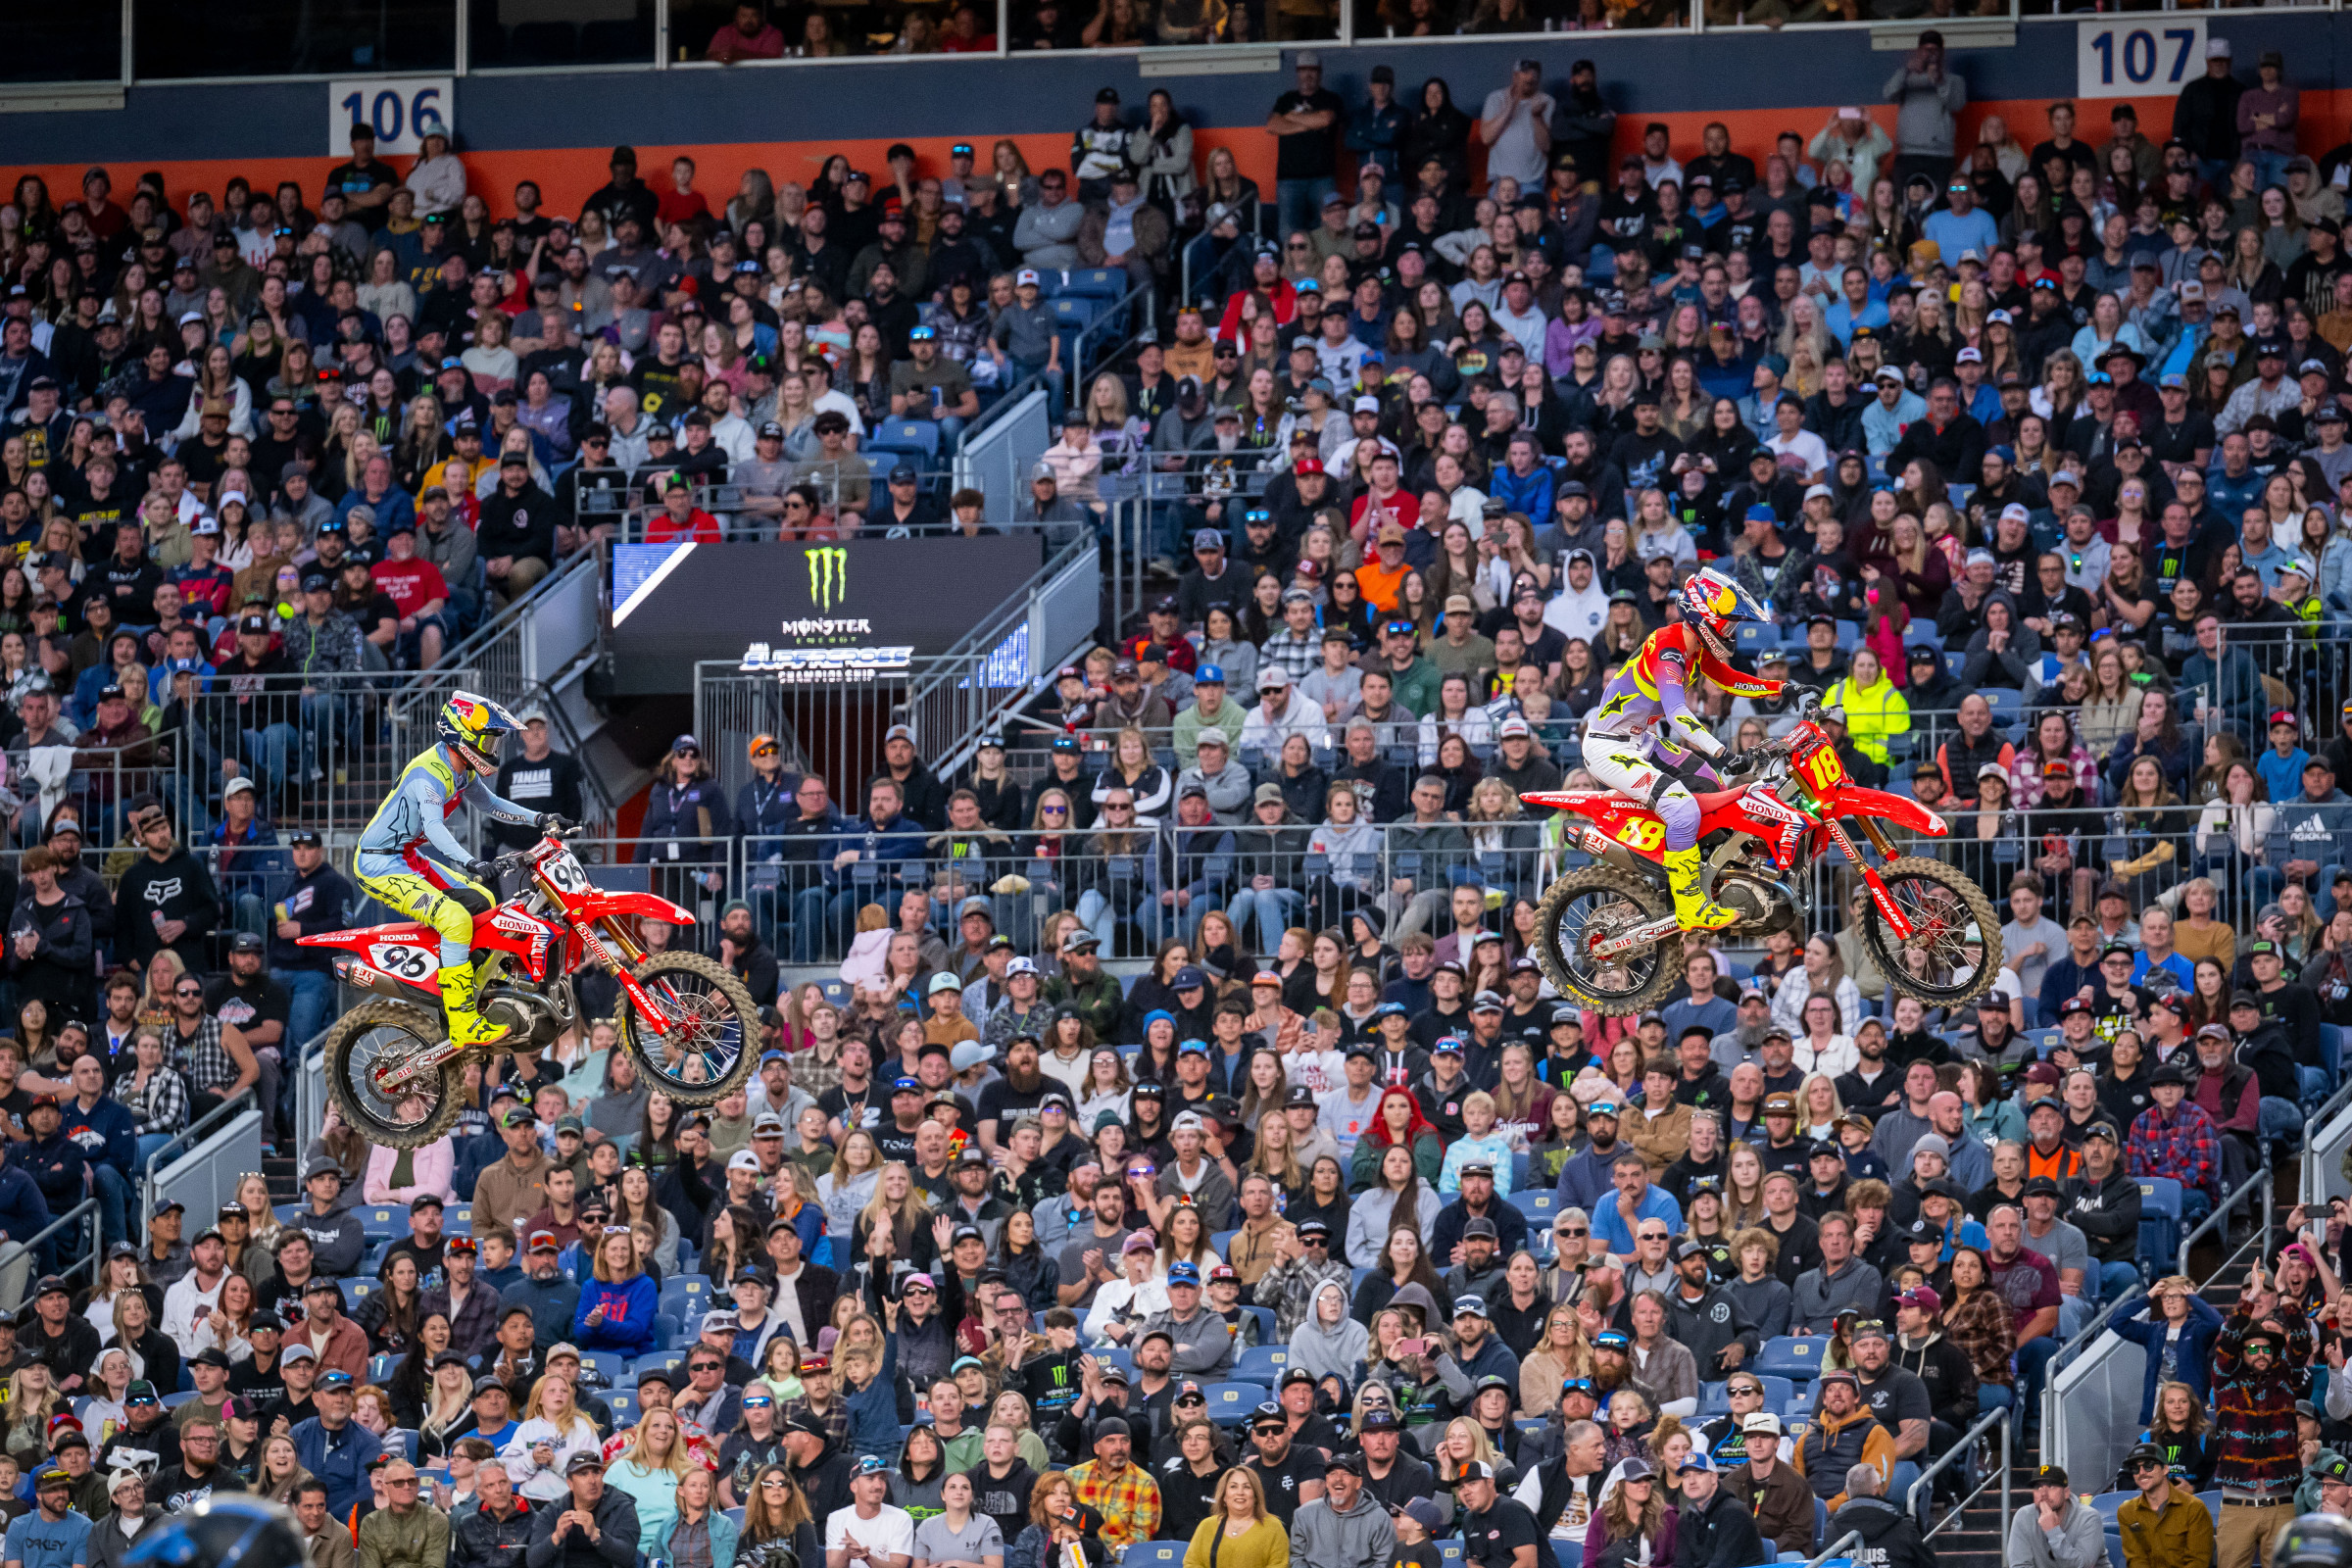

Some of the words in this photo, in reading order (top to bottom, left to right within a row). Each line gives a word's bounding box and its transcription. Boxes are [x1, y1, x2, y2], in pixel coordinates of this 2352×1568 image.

[2091, 27, 2195, 85] 107
[341, 87, 443, 143] 106
[1687, 585, 1722, 625] 100%
[781, 617, 872, 637] MONSTER
[1733, 681, 1769, 692] HONDA
[513, 767, 552, 784] YAMAHA
[1809, 745, 1841, 791] 18
[491, 809, 528, 822] HONDA
[1540, 796, 1587, 805] DUNLOP
[1745, 801, 1794, 822] HONDA
[1616, 816, 1668, 852] 18
[1827, 823, 1860, 859] SHOWA
[554, 862, 588, 893] 96
[1871, 886, 1904, 929] DUNLOP
[379, 934, 420, 943] HONDA
[499, 918, 542, 933] HONDA
[578, 926, 610, 960] SHOWA
[383, 946, 427, 979] 96
[627, 983, 663, 1022] DUNLOP
[24, 1537, 69, 1552] OAKLEY
